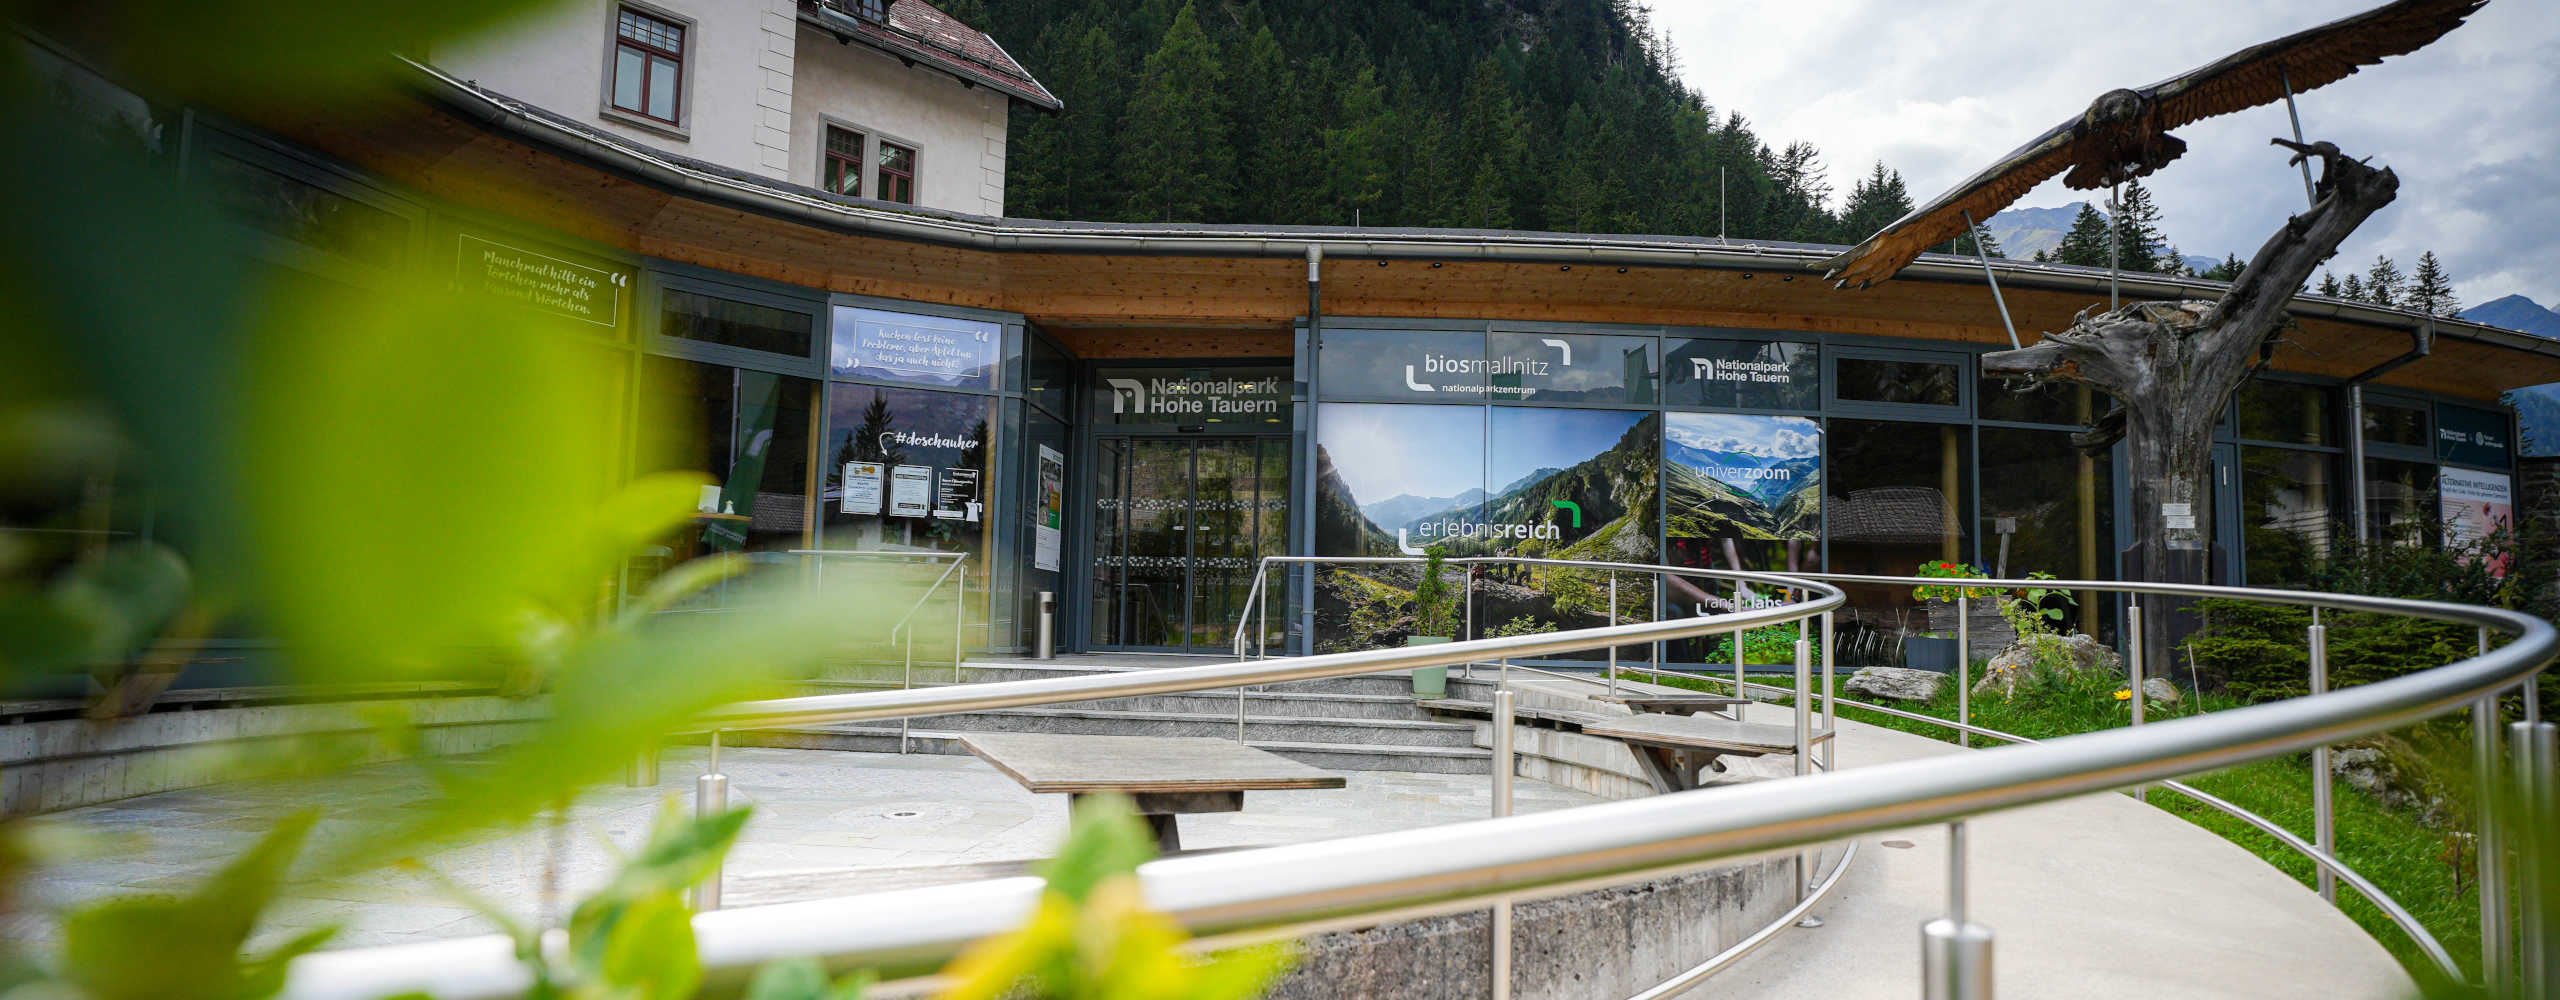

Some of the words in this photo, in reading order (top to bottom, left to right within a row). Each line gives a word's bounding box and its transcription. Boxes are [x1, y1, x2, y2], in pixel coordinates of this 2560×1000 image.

[483, 250, 548, 277] Manchmal
[550, 265, 576, 285] hilft
[578, 273, 597, 289] ein
[539, 278, 570, 297] mehr
[572, 281, 591, 300] als
[1425, 353, 1549, 376] biosmallnitz
[1716, 359, 1790, 373] Nationalpark
[1716, 370, 1747, 381] Hohe
[1749, 371, 1790, 383] Tauern
[1151, 377, 1278, 397] Nationalpark
[1442, 383, 1536, 395] nationalparkzentrum
[1151, 396, 1204, 413] Hohe
[1207, 396, 1277, 413] Tauern
[894, 431, 979, 450] #doschauher
[1695, 464, 1790, 481] univerzoom
[1419, 517, 1560, 540] erlebnisreich
[1704, 595, 1782, 613] rangrlabs
